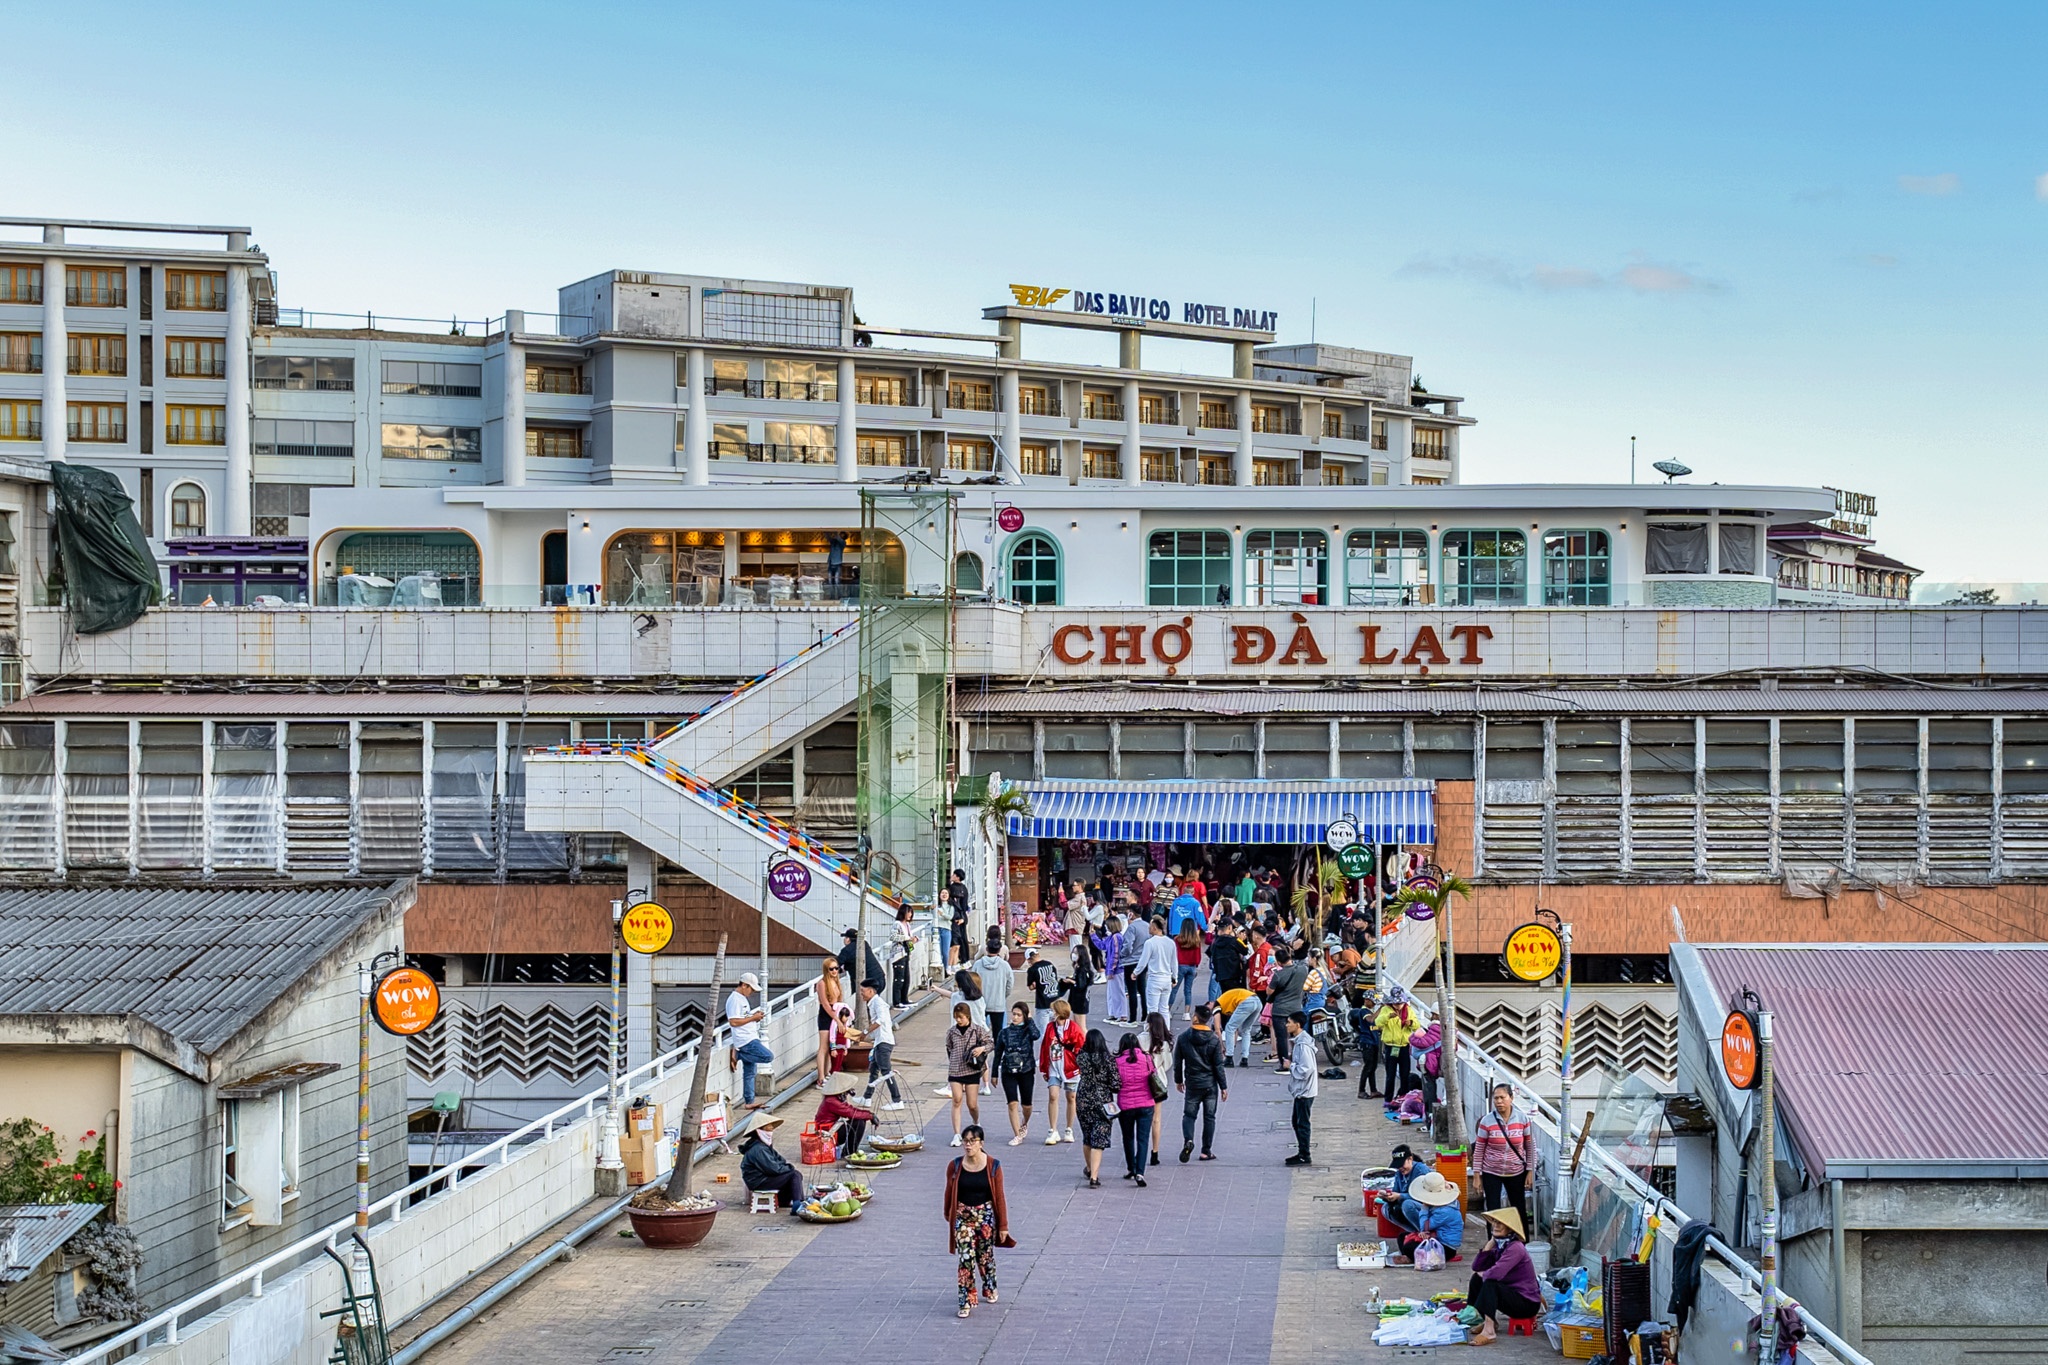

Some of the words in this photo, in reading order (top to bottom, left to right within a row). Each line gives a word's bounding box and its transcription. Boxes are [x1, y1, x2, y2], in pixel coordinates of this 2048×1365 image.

[1074, 290, 1105, 314] DAS
[1184, 302, 1230, 326] HOTEL
[1233, 308, 1278, 332] DALAT
[1845, 491, 1878, 517] HOTEL
[1052, 616, 1193, 676] CHỢ
[1231, 612, 1328, 665] ĐÀ
[1359, 625, 1494, 676] LẠT
[1331, 830, 1353, 838] WOW
[1341, 854, 1371, 864] WOW
[773, 871, 806, 884] WOW
[627, 918, 668, 930] WOW
[1512, 941, 1556, 954] WOW
[381, 985, 432, 1006] WOW
[1725, 1033, 1752, 1055] WOW
